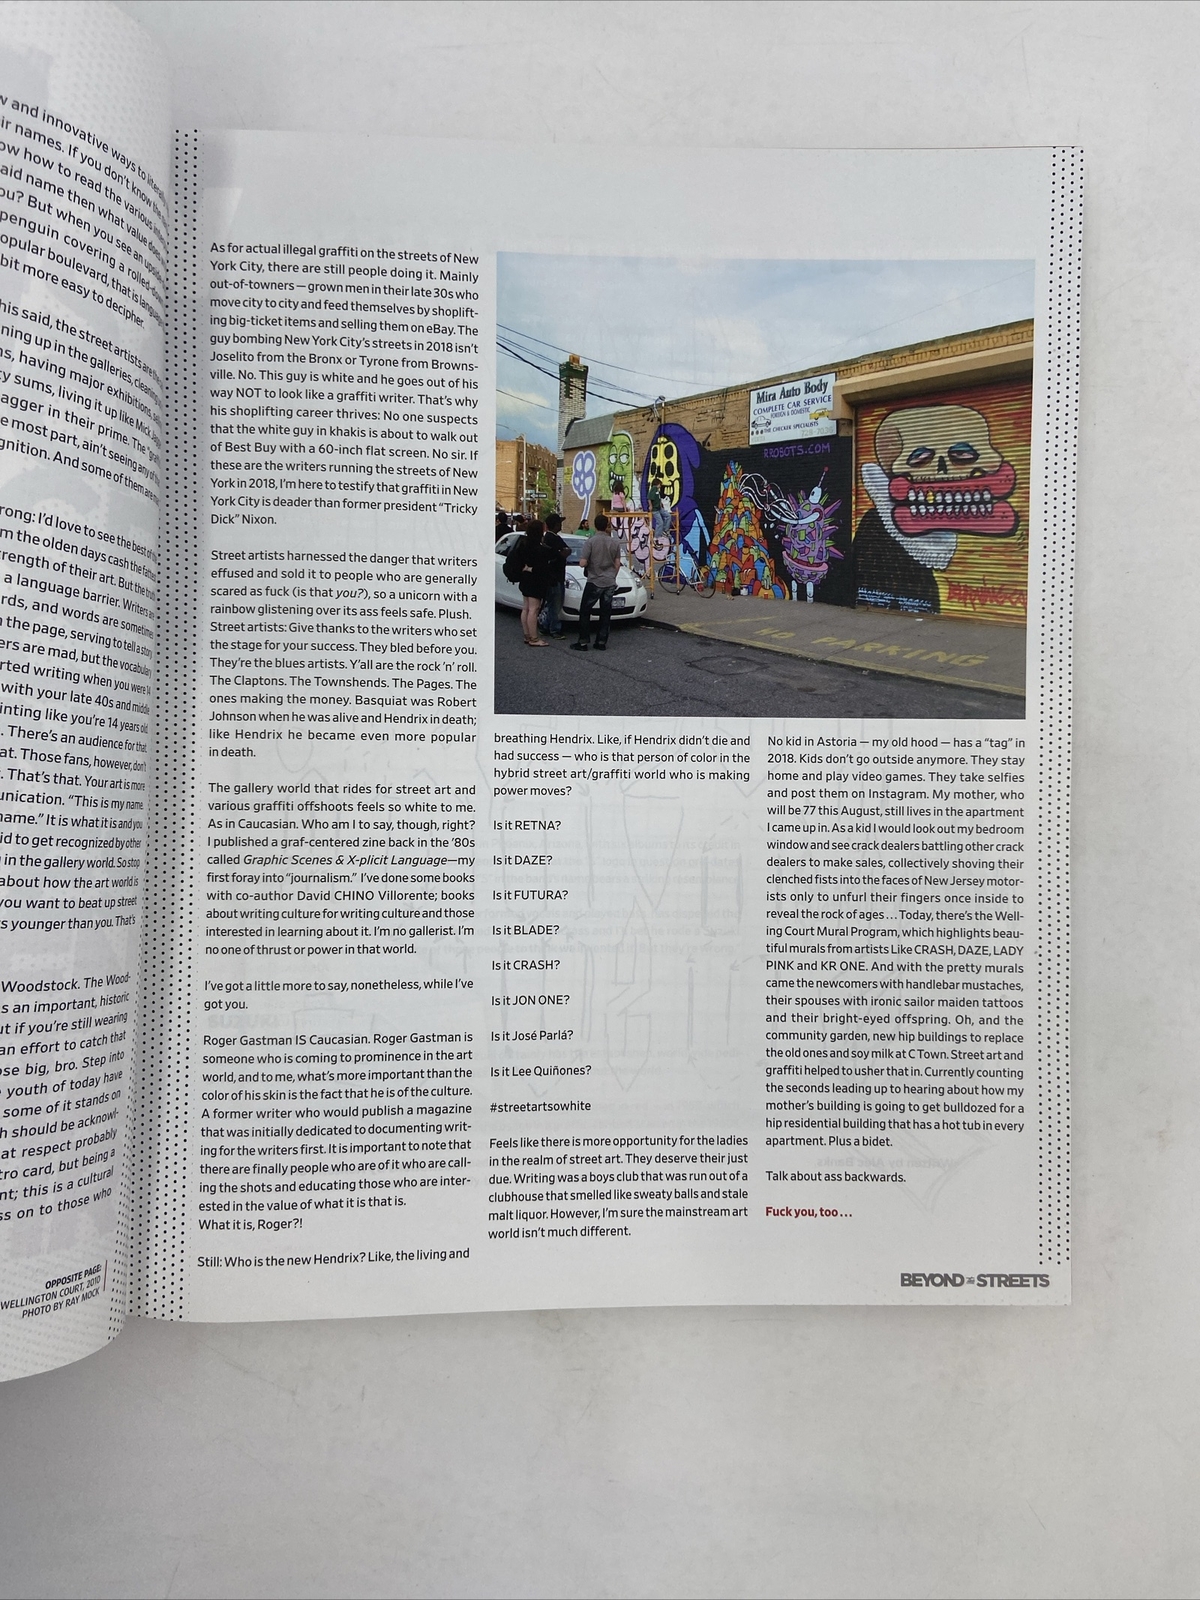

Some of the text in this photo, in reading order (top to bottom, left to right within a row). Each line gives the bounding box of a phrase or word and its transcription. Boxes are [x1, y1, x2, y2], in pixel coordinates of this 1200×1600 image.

[11, 99, 146, 181] and innovative ways to
[209, 242, 480, 265] As for actual illegal graffiti on the streets of New
[22, 264, 59, 285] more
[61, 279, 90, 299] easy
[92, 292, 103, 304] to
[105, 295, 145, 329] decipher.
[756, 379, 828, 404] Mira Auto Body
[753, 395, 832, 416] COMPLETE CAR SERVICE
[770, 409, 786, 419] FOREIGN
[791, 407, 810, 416] DOMESTIC
[48, 404, 146, 454] in their prime. The
[793, 421, 819, 430] SPECIALISTS
[754, 628, 990, 668] NO PARKING
[8, 725, 58, 742] There’s
[60, 733, 76, 744] an
[78, 735, 123, 750] audience
[124, 740, 135, 752] for
[493, 732, 751, 748] breathing Hendrix. Like, if Hendrix didn’t die and
[208, 746, 257, 758] in death.
[767, 769, 1026, 787] home and play video games. They take selfies
[493, 819, 562, 831] Is it RETNA?
[493, 854, 502, 866] Is
[504, 854, 512, 866] it
[514, 854, 553, 866] DAZE?
[492, 889, 569, 901] Is it FUTURA?
[492, 925, 501, 936] Is
[503, 924, 511, 936] it
[513, 924, 560, 936] BLADE?
[491, 959, 561, 971] Is it CRASH?
[1, 973, 131, 993] Woodstock. The Wood-
[203, 998, 249, 1012] got you.
[491, 994, 571, 1007] Is it JON ONE?
[490, 1029, 574, 1042] Is it José Parlá?
[490, 1066, 500, 1078] Is
[501, 1066, 510, 1077] it
[511, 1066, 532, 1077] Lee
[533, 1064, 592, 1078] Quiñones?
[3, 1090, 121, 1118] some of it stands on
[489, 1100, 592, 1113] #streetartsowhite
[765, 1135, 893, 1148] apartment. Plus a bidet.
[765, 1170, 907, 1183] Talk about ass backwards.
[16, 1186, 112, 1219] on to those who
[765, 1205, 793, 1217] Fuck
[793, 1208, 818, 1219] you,
[198, 1217, 303, 1232] What it is, Roger?!
[487, 1225, 632, 1240] world isn’t much different.
[196, 1247, 470, 1268] Still: Who is the new Hendrix? Like, the living and
[45, 1264, 102, 1290] OPPOSITE PAGE:
[900, 1272, 965, 1287] BEYOND
[976, 1273, 1050, 1288] STREETS
[0, 1276, 101, 1310] WELLINGTON COURT, 2010
[21, 1287, 100, 1319] PHOTO BY RAY MOCK
